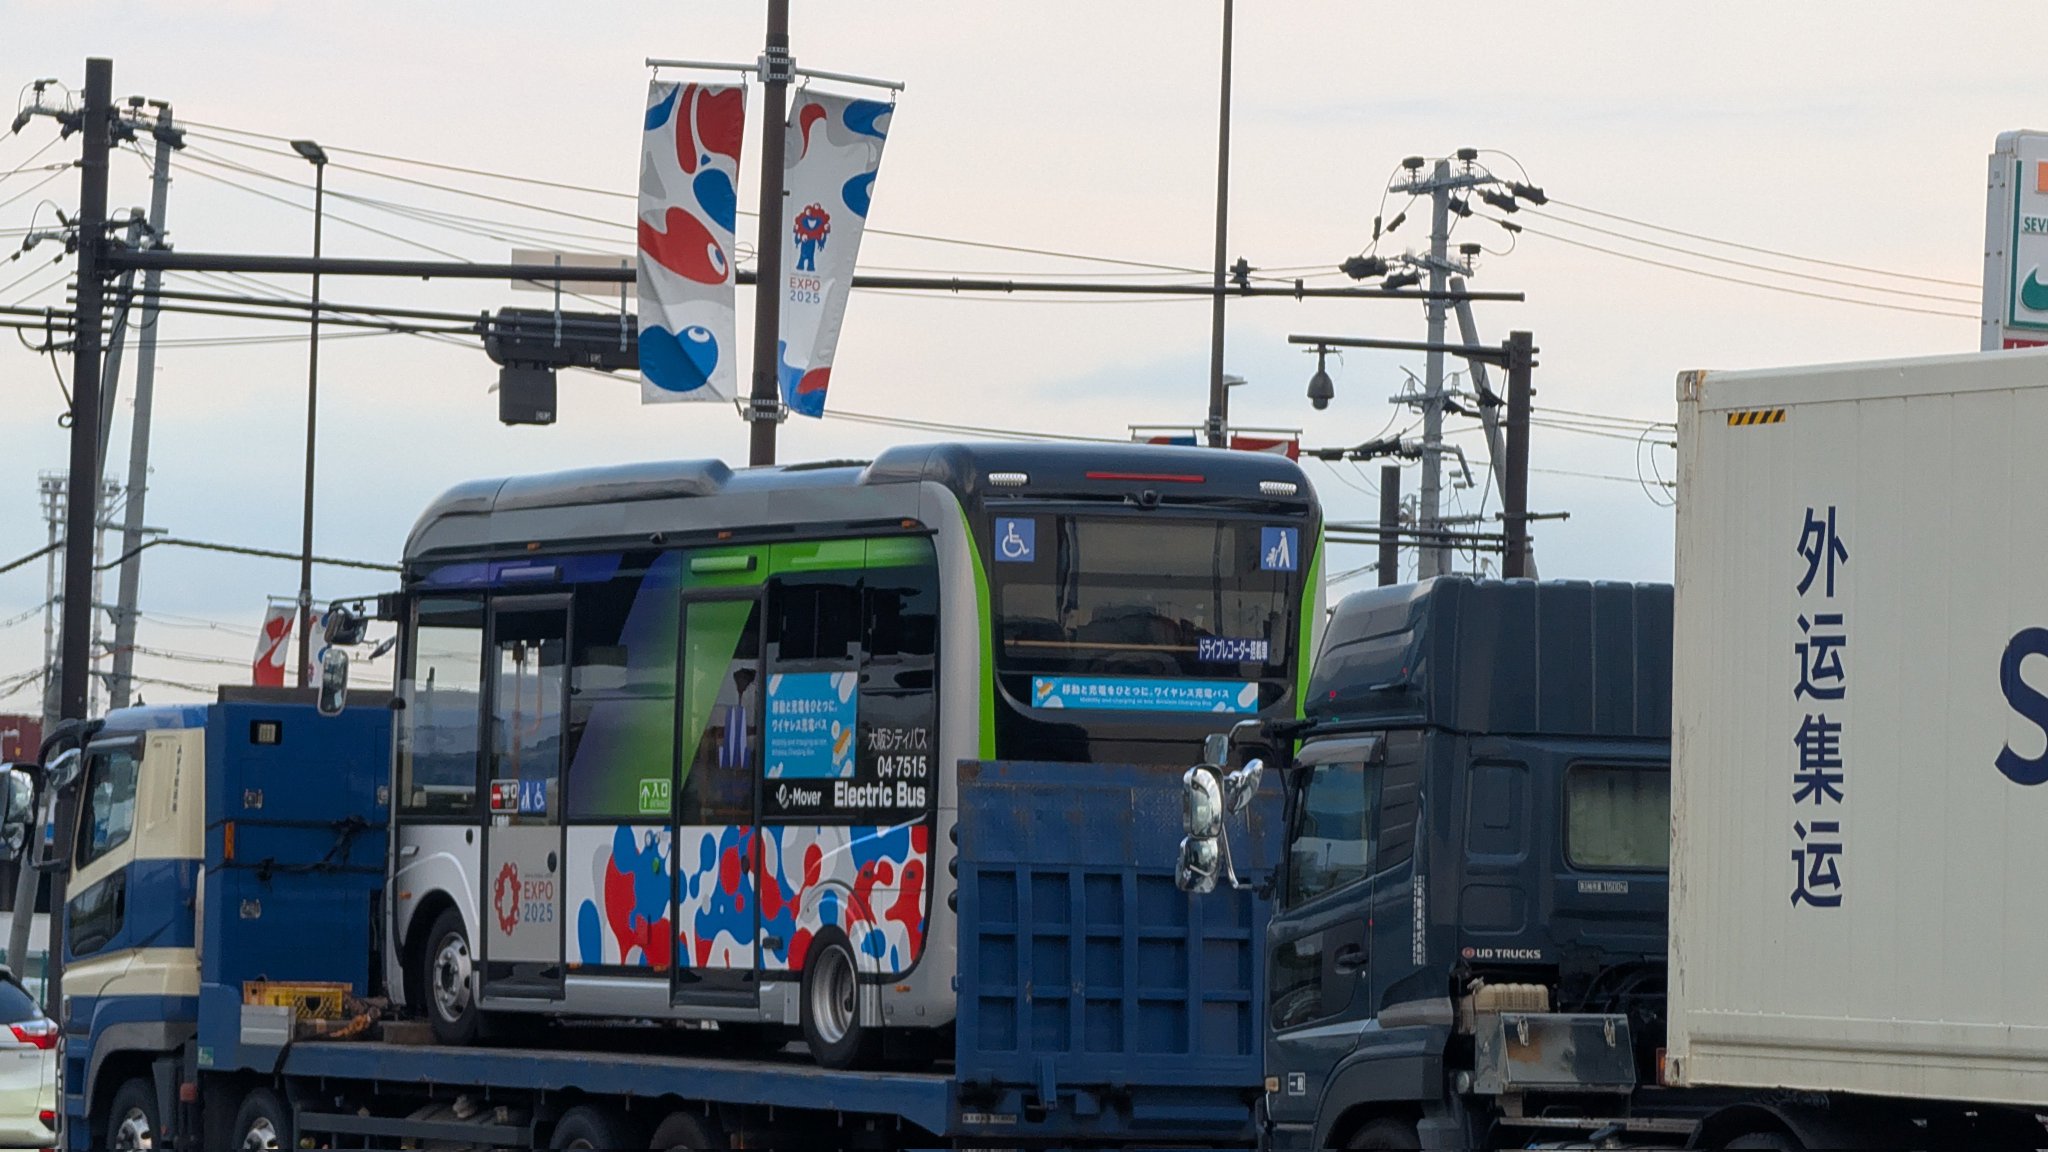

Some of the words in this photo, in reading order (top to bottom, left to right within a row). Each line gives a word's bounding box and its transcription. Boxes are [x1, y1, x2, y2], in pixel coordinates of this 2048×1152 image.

[790, 277, 820, 291] EXPO
[790, 290, 820, 304] 2025
[1790, 505, 1848, 909] 外运集运
[868, 728, 927, 750] 大阪シティバス
[651, 782, 668, 798] 入口
[834, 781, 892, 808] Electric
[896, 781, 926, 808] Bus
[524, 881, 554, 900] EXPO
[524, 903, 554, 923] 2025
[1476, 948, 1493, 959] UD
[1495, 948, 1542, 959] TRUCKS
